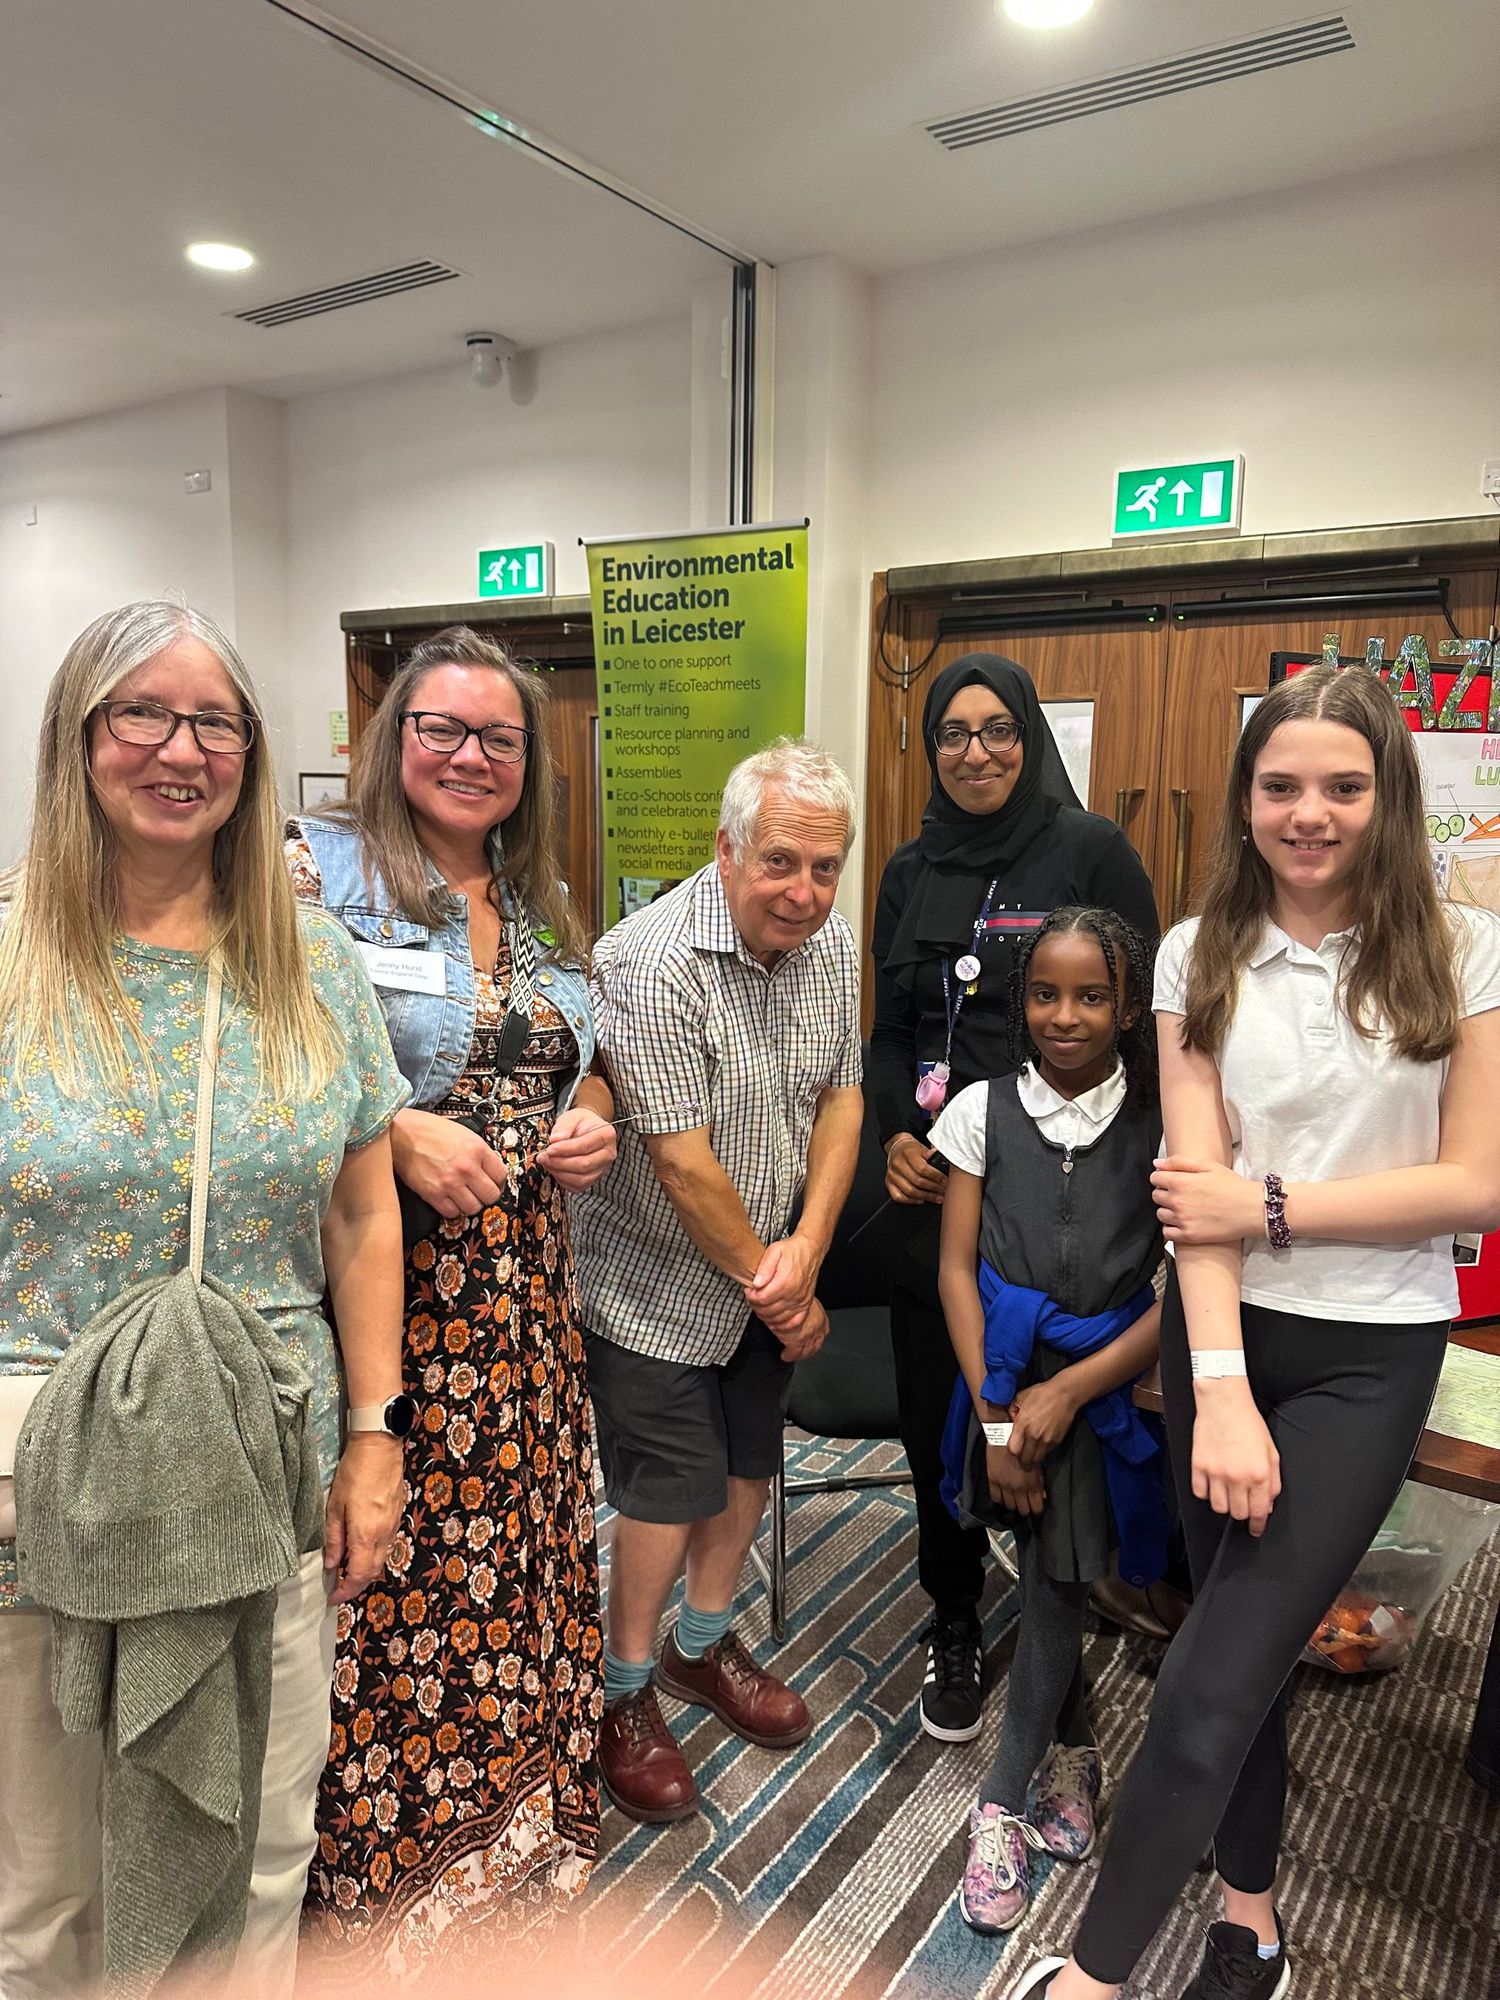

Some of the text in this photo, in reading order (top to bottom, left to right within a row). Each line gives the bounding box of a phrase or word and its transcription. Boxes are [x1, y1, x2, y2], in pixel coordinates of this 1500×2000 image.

[602, 543, 794, 582] Environmental
[603, 584, 730, 614] Education
[603, 617, 745, 646] in Leicester
[613, 654, 732, 671] One to one support
[613, 677, 761, 696] Termly #EcoTeachmeets
[614, 704, 690, 719] Staff training
[615, 726, 750, 743] Resource planning and
[616, 743, 681, 758] workshops
[616, 767, 682, 779] Assemblies
[616, 788, 691, 802] Eco-Schools
[616, 805, 638, 817] and
[641, 804, 708, 818] celebration
[617, 827, 665, 841] Monthly
[617, 843, 709, 856] newsletters and
[618, 857, 692, 871] social media
